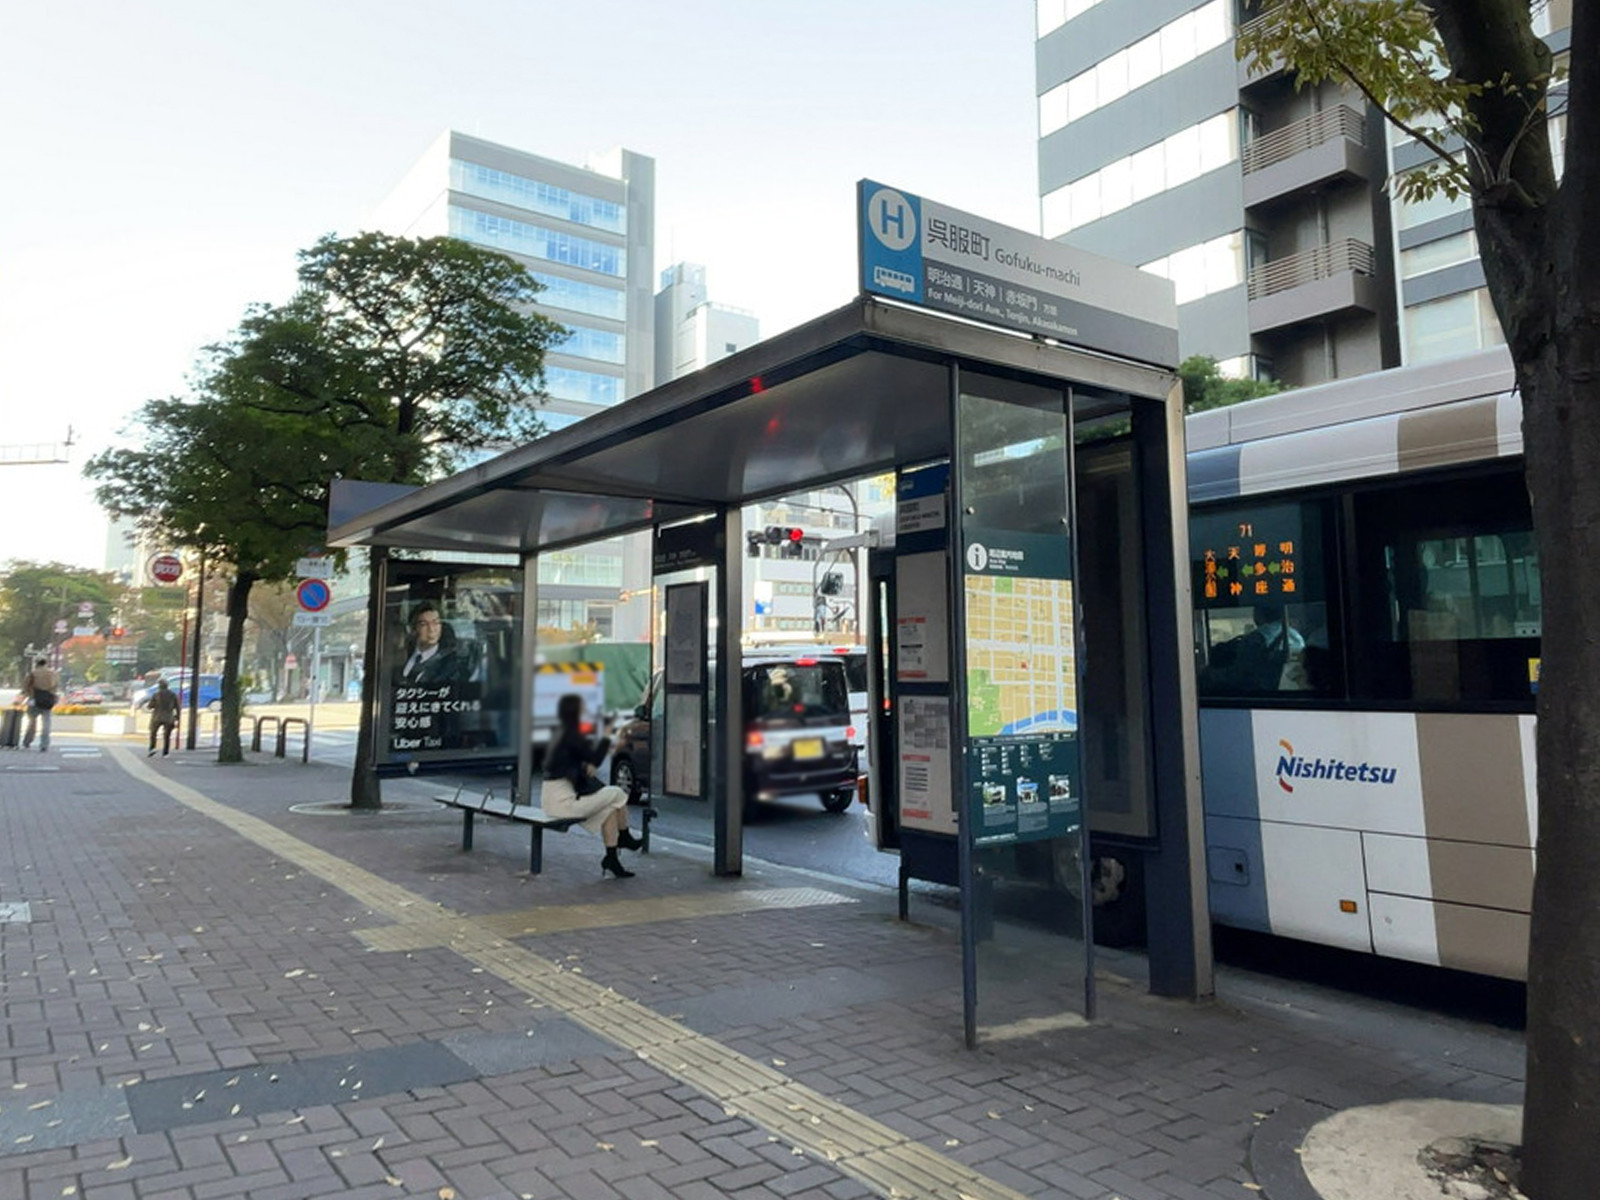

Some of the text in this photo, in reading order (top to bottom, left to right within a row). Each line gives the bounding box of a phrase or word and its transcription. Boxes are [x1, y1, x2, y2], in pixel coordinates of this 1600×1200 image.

[881, 199, 904, 239] H
[928, 218, 1080, 286] 呉服町 Gofuku-machi
[927, 287, 943, 300] For
[973, 279, 996, 299] 天神
[1239, 523, 1253, 538] 71
[396, 686, 451, 699] タクシーが
[395, 716, 432, 730] 安心感
[394, 738, 421, 749] Uber
[1276, 755, 1397, 785] Nishitetsu
